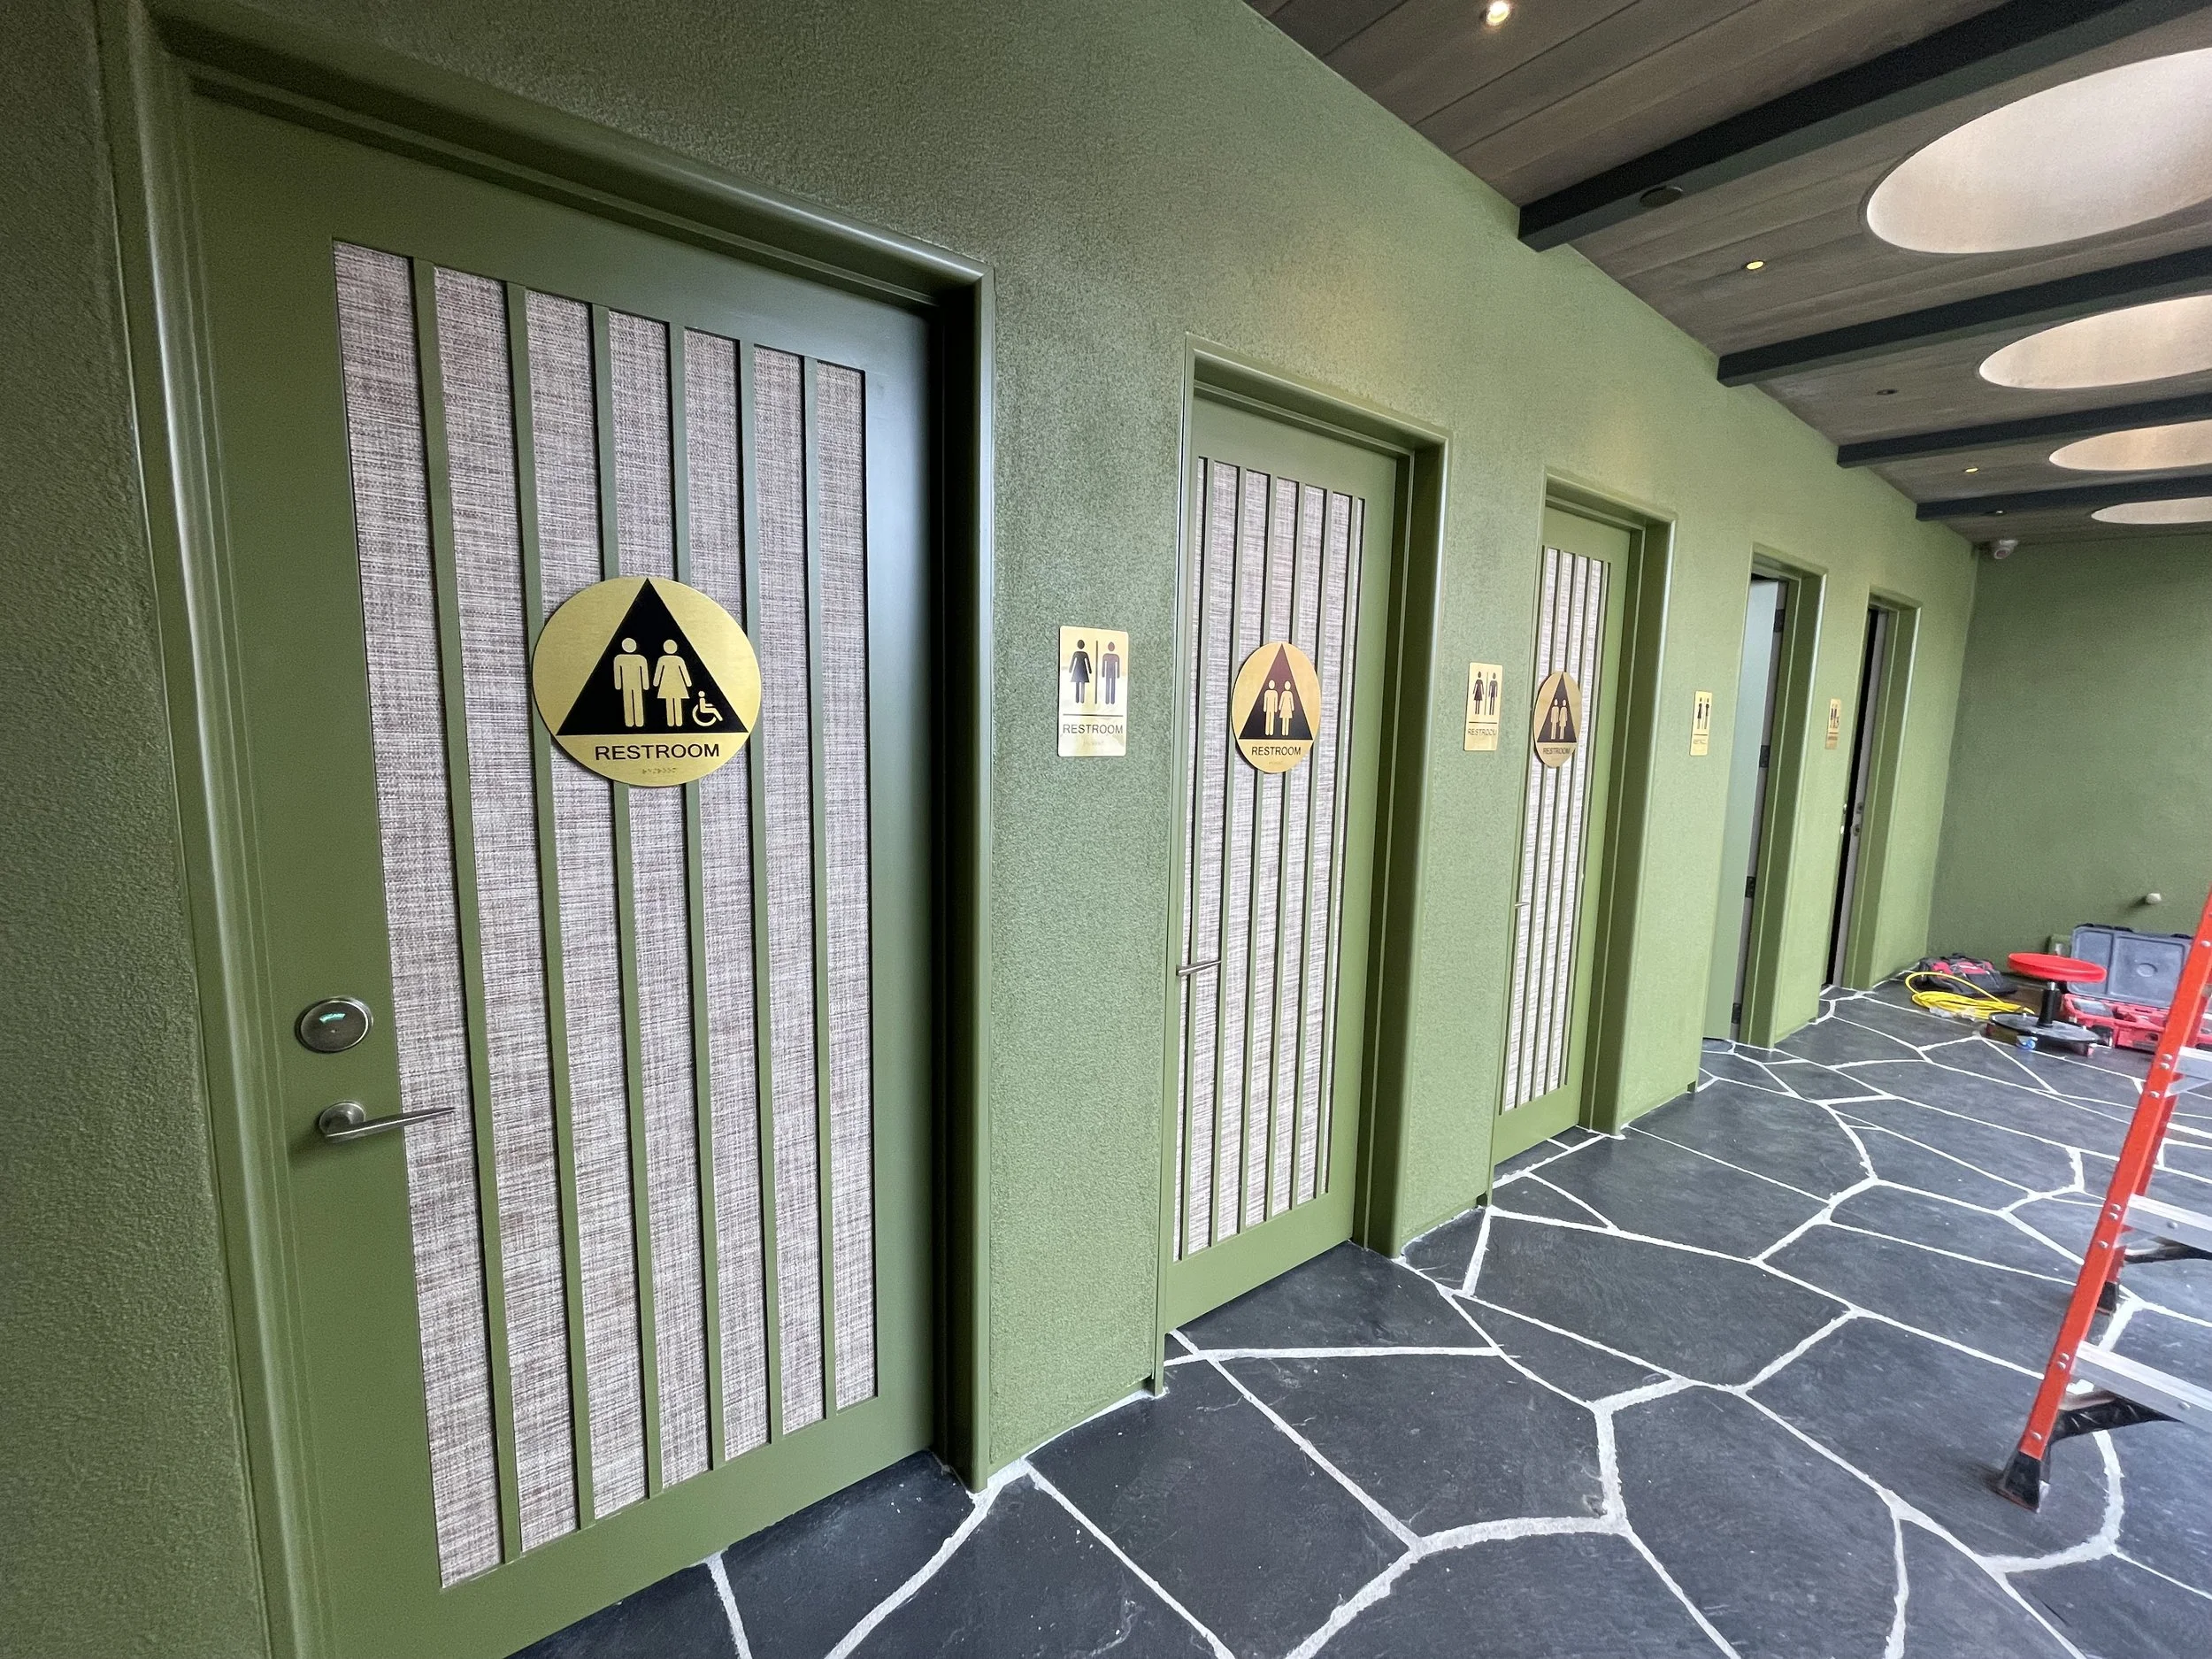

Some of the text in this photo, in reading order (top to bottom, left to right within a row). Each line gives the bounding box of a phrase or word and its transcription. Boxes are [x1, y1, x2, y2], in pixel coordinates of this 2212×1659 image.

[1063, 724, 1124, 734] RESTROOM
[595, 743, 719, 761] RESTROOM
[1251, 746, 1302, 756] RESTROOM
